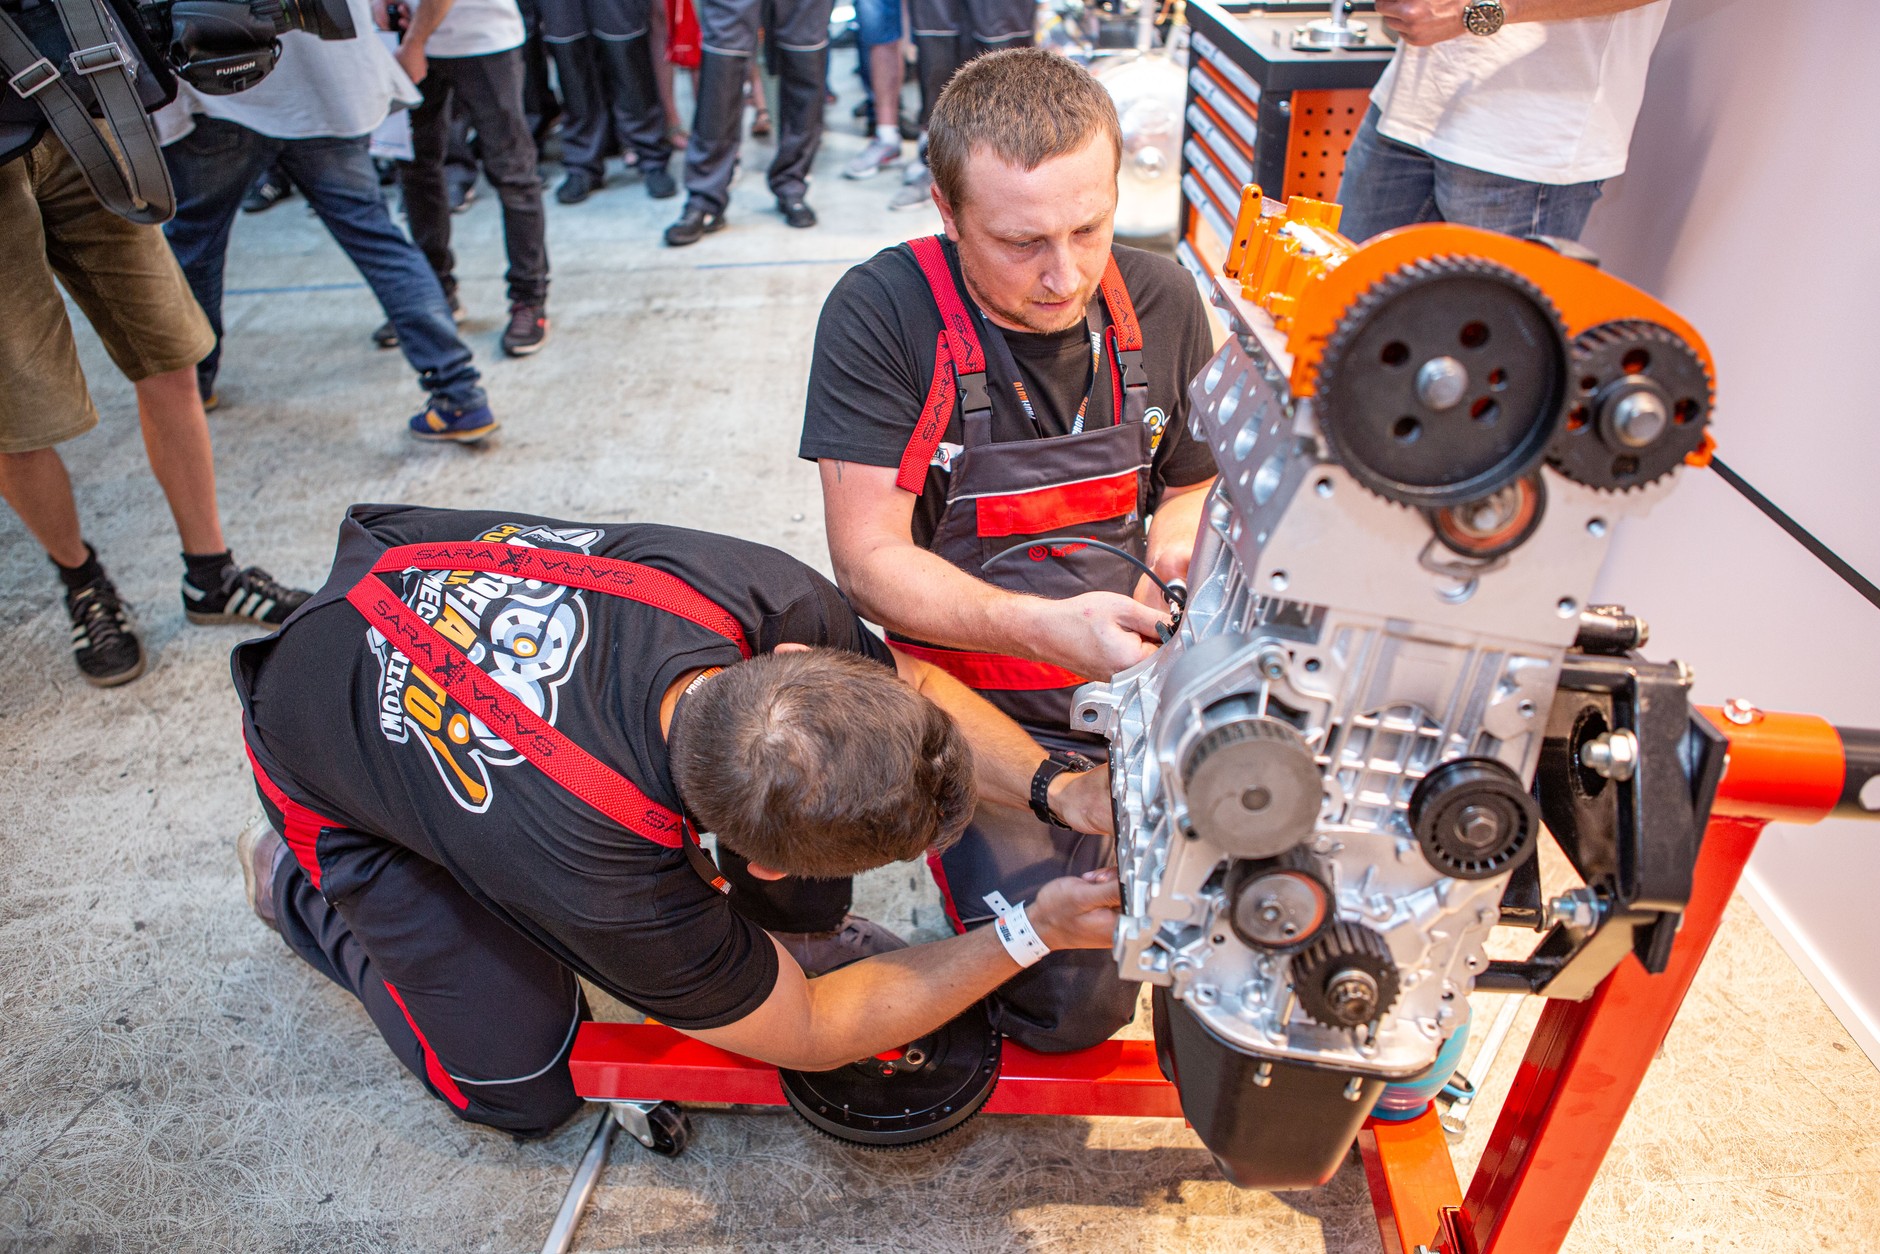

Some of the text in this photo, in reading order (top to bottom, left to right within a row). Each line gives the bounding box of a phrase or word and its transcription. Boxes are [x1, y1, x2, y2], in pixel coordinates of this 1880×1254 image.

[216, 61, 256, 76] FUJINON
[1071, 396, 1089, 435] PROFIAUTO
[413, 548, 495, 562] SARA
[539, 557, 635, 585] SARA
[372, 599, 433, 663] SARA
[471, 680, 557, 757] SARA
[642, 809, 681, 835] SA
